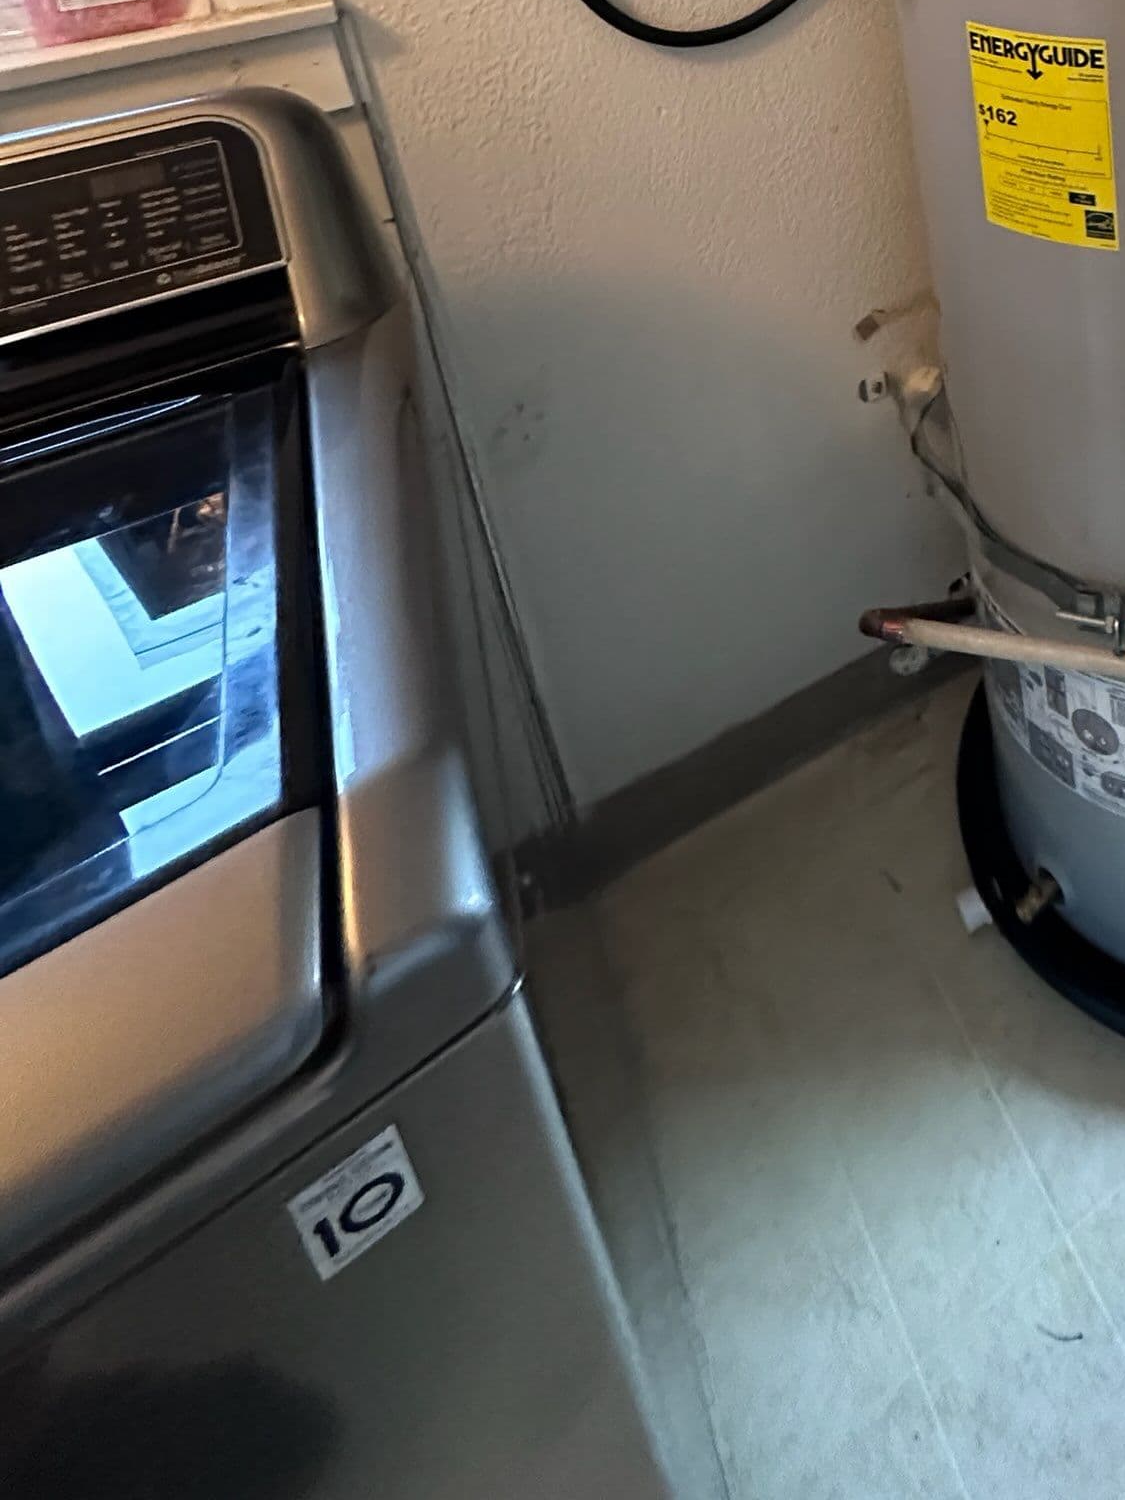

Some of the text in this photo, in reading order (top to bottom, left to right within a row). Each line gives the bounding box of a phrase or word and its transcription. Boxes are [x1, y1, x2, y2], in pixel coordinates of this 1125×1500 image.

[969, 31, 1105, 72] ENERGYGUIDE
[978, 103, 1018, 127] $162
[313, 1172, 405, 1257] 10
